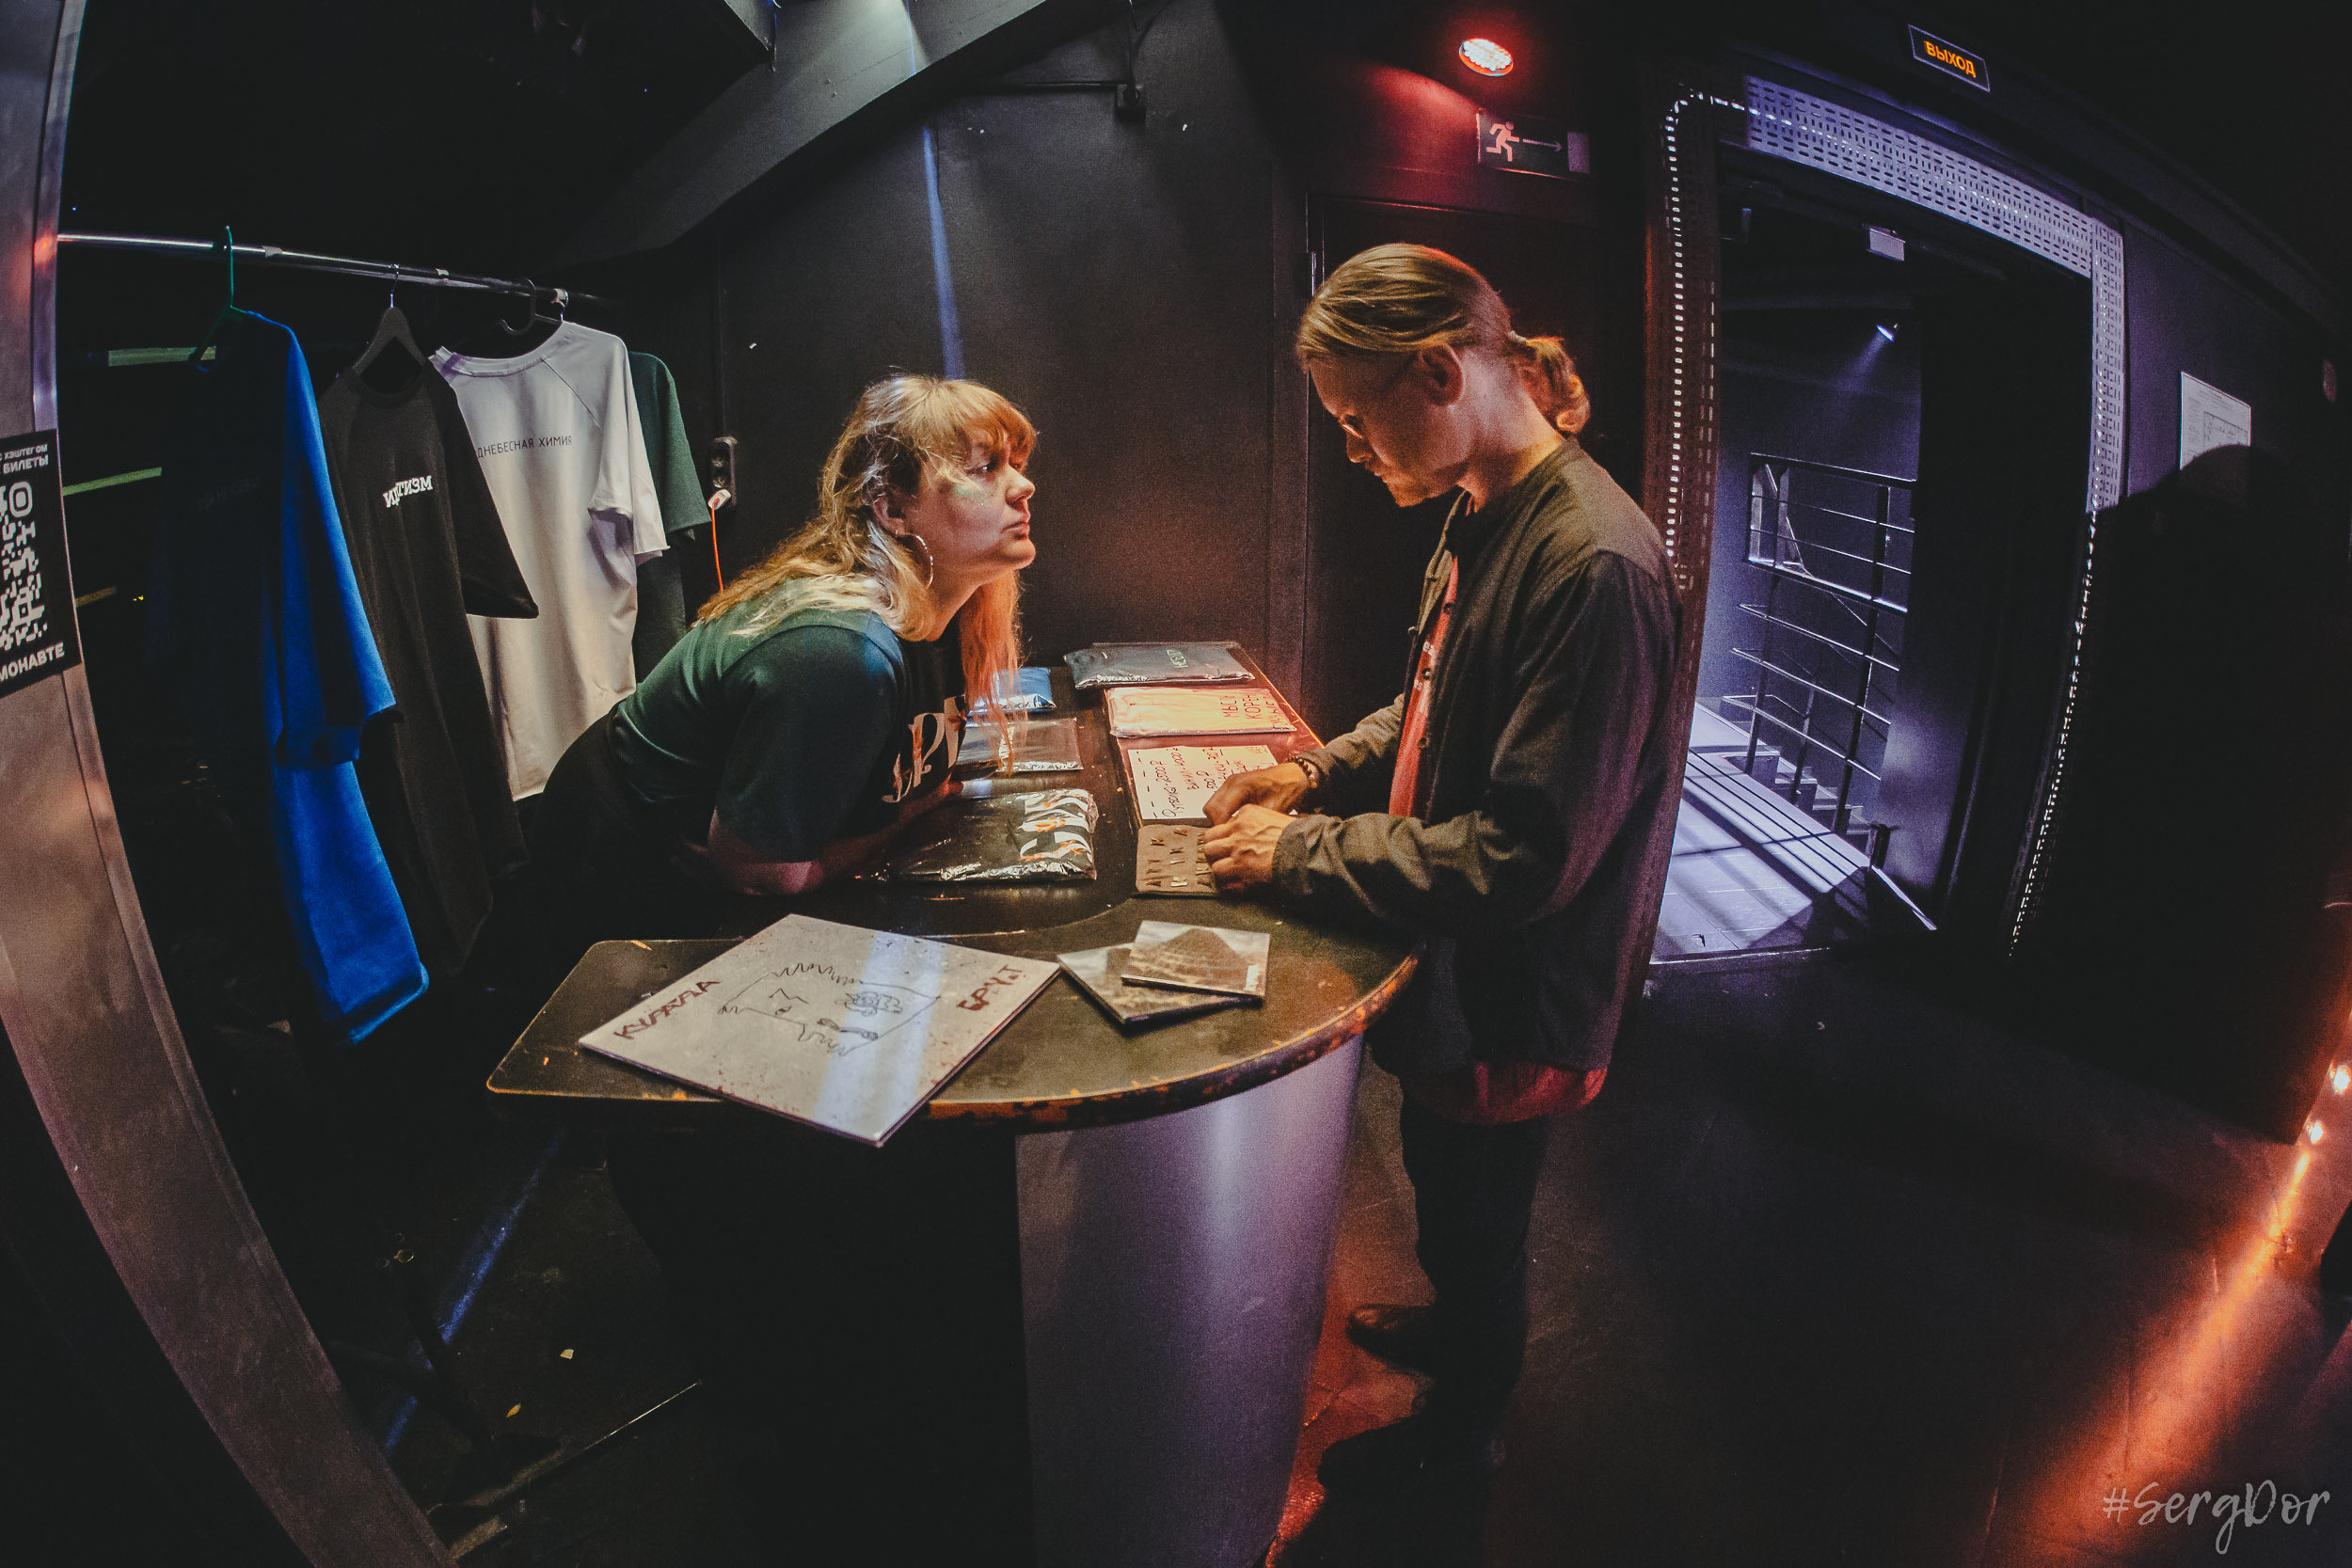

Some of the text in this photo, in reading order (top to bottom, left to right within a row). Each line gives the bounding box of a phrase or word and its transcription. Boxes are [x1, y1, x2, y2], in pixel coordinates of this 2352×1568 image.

[1924, 40, 1977, 78] ВЫХОД
[538, 436, 572, 448] ХИМИЯ
[3, 454, 49, 474] БИЛЕТЫ
